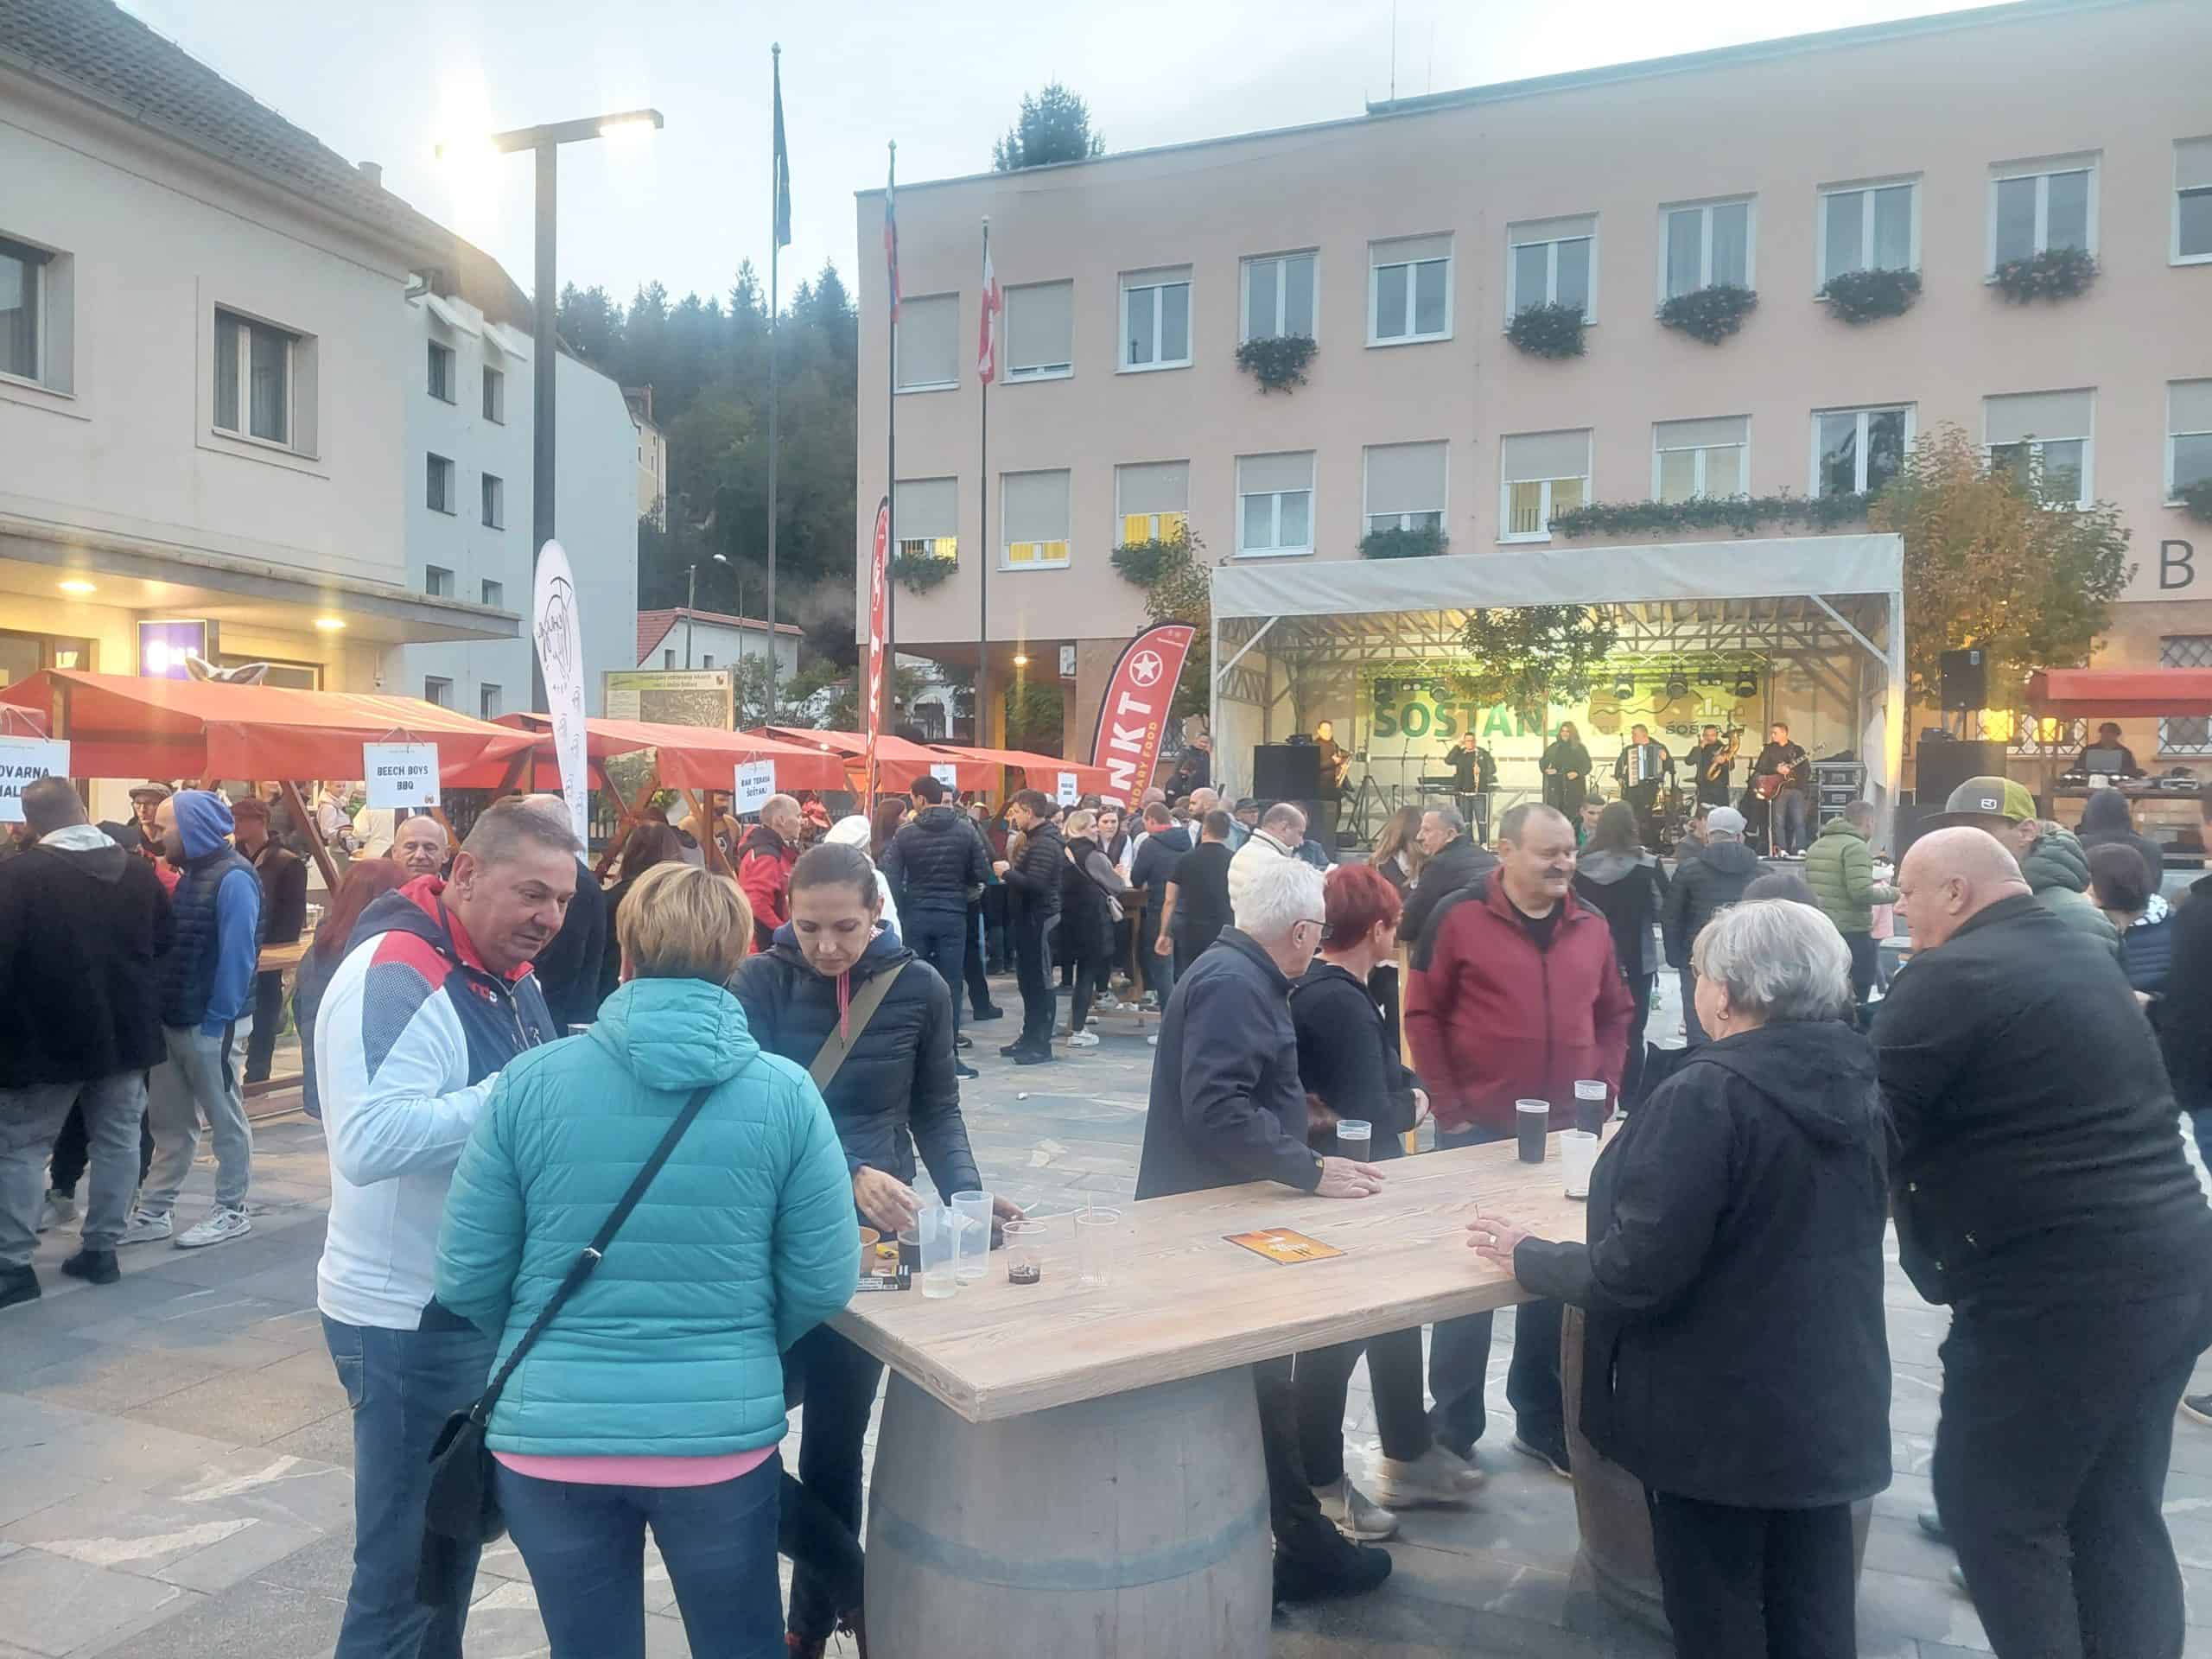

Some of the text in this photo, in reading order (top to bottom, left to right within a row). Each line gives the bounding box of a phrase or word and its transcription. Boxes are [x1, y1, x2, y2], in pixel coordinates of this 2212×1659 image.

[2160, 539, 2195, 589] B
[1142, 721, 1158, 758] FOOD
[377, 766, 429, 777] BEECH BOYS
[397, 781, 414, 791] BBQ
